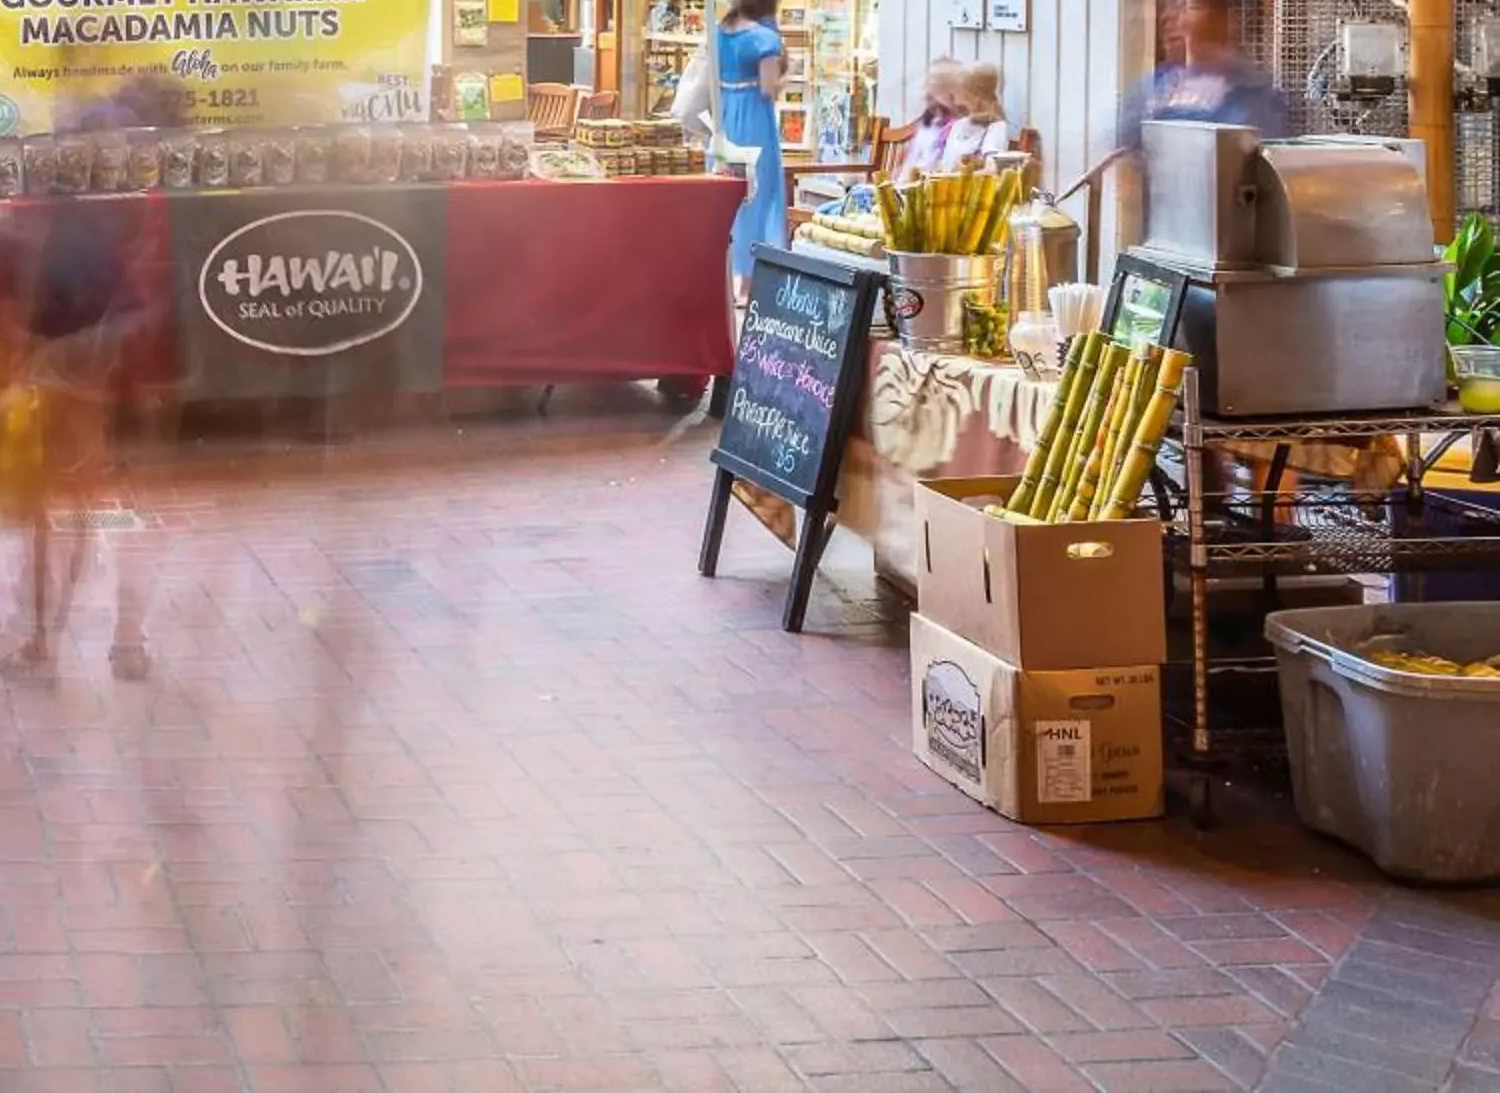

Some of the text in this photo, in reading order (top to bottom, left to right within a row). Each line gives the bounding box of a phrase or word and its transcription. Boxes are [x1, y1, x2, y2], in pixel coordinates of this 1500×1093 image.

[22, 9, 339, 45] MACADAMIA NUTS
[12, 66, 59, 81] Always
[221, 63, 240, 73] on
[241, 62, 264, 73] our
[268, 59, 310, 74] family
[238, 297, 386, 320] SEAL of QUALITY
[804, 319, 837, 359] Juice
[1049, 727, 1084, 740] HNL
